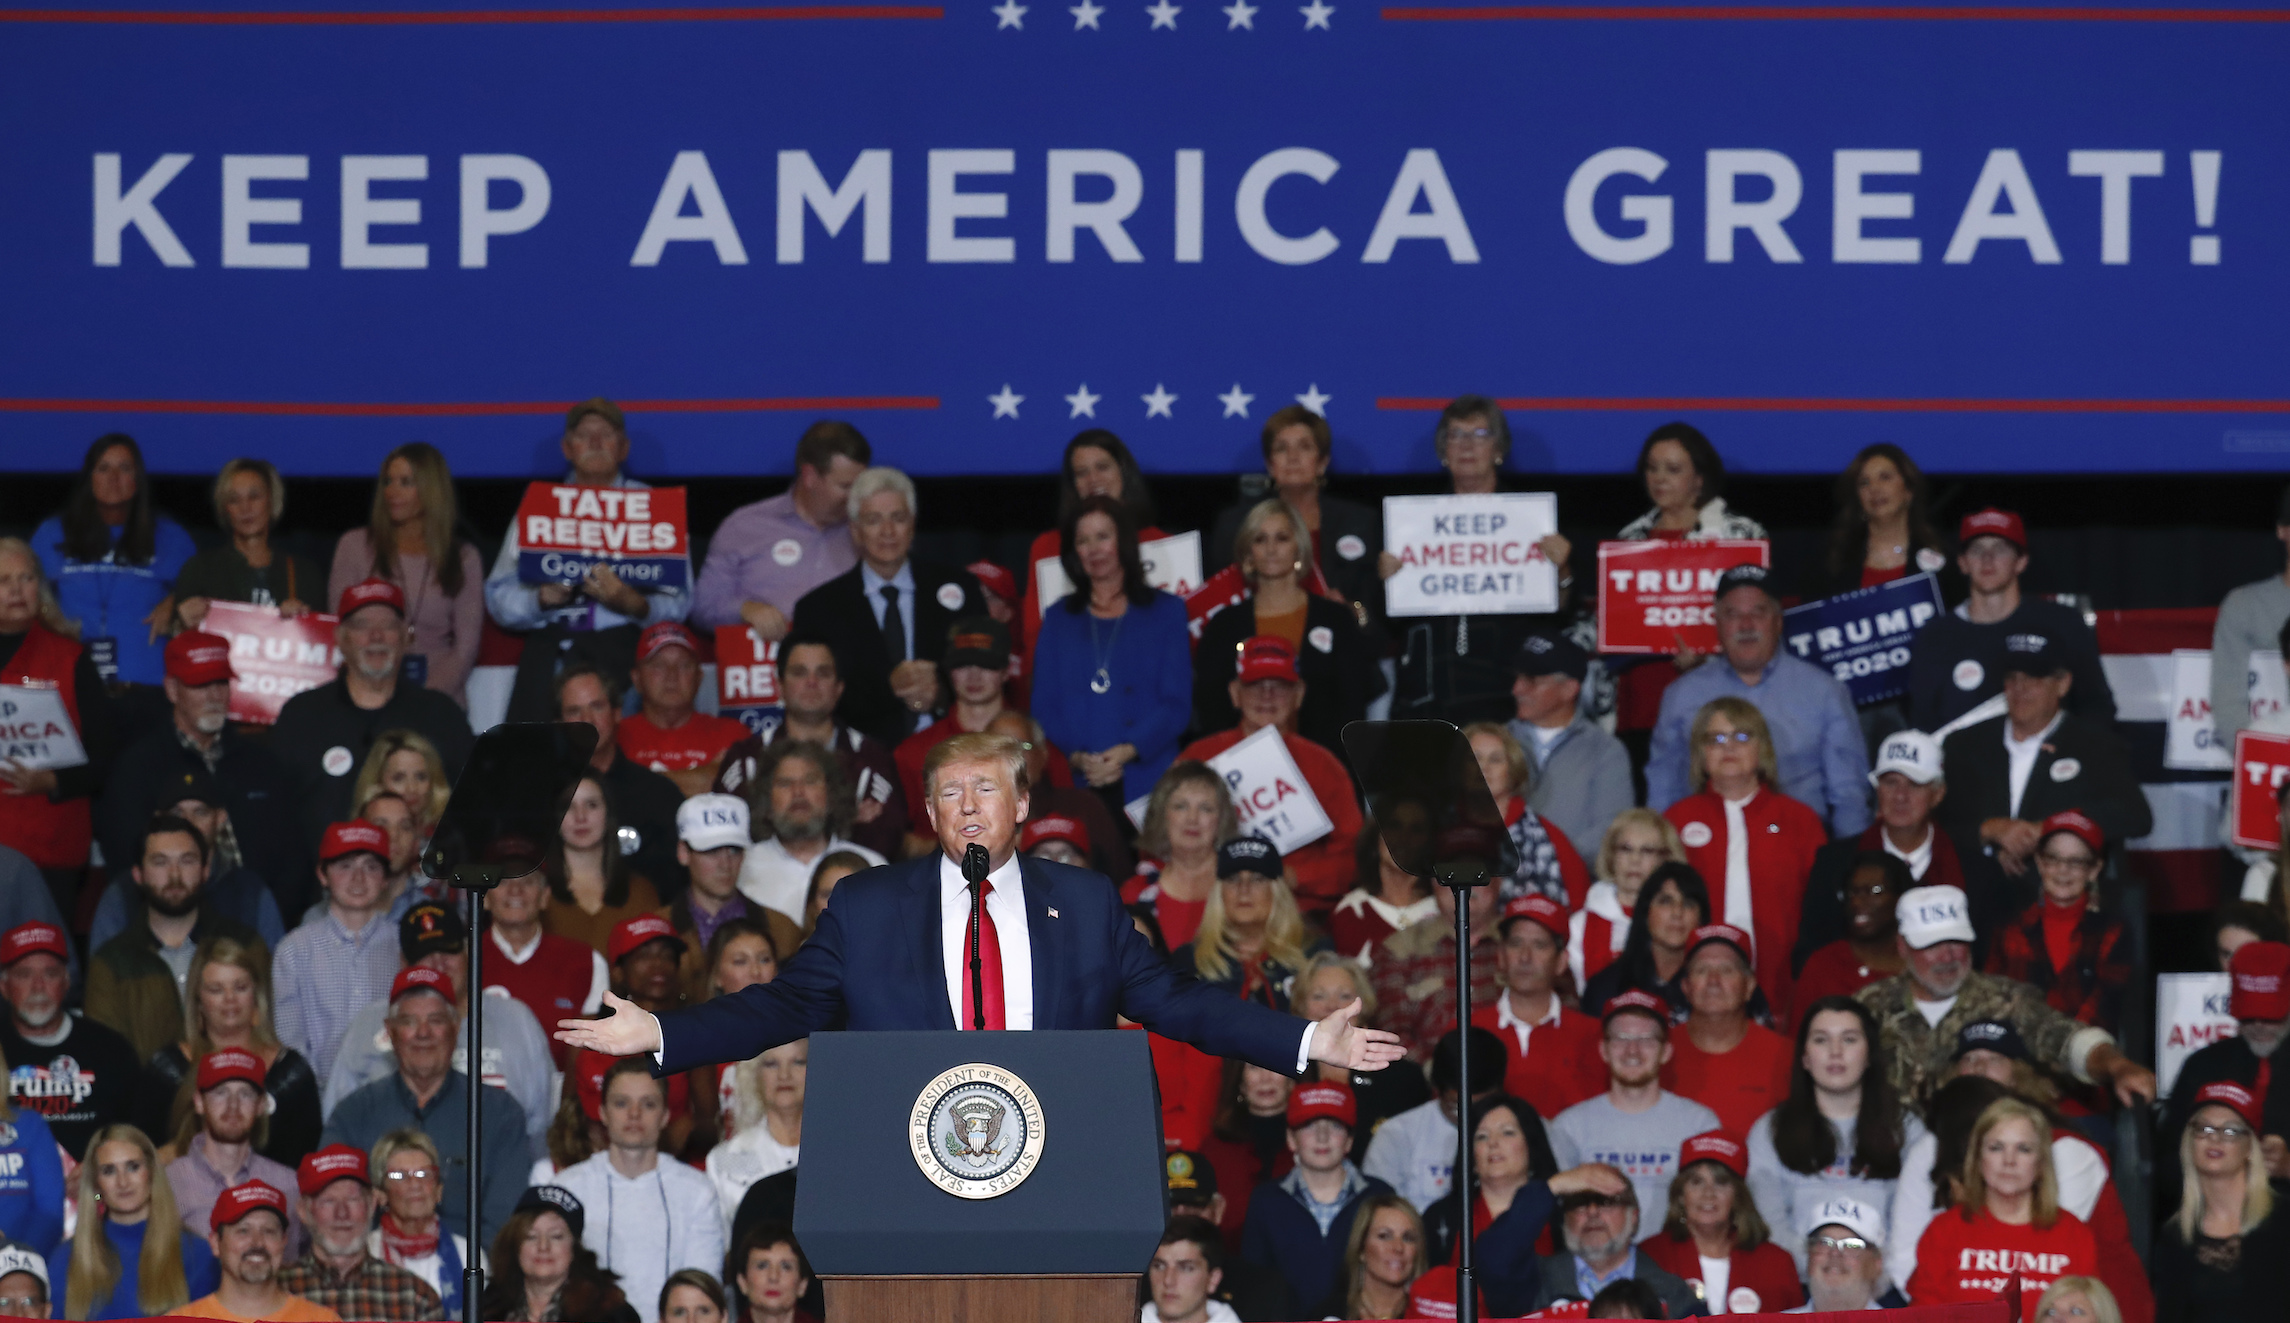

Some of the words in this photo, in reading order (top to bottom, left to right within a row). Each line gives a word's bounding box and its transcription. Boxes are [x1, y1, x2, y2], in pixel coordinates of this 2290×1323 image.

[94, 154, 551, 269] KEEP
[631, 149, 1479, 266] AMERICA
[1564, 147, 2221, 264] GREAT!
[552, 486, 650, 521] TATE
[526, 515, 677, 551] REEVES
[1434, 514, 1507, 536] KEEP
[541, 553, 664, 581] Govrnor
[1401, 542, 1546, 567] AMERICA
[1420, 572, 1525, 596] GREAT!
[1609, 568, 1724, 593] TRUM
[1788, 601, 1936, 657] TRUMP
[1832, 646, 1912, 682] 2020
[1887, 742, 1920, 764] USA
[702, 809, 741, 827] USA
[1919, 903, 1959, 925] USA
[978, 1070, 992, 1079] OF
[993, 1073, 1011, 1087] THE
[913, 1068, 975, 1128] PRESIDENT
[1012, 1085, 1041, 1140] UNITED
[915, 1131, 927, 1151] THE
[920, 1152, 932, 1165] OF
[1594, 1152, 1672, 1165] TRUMP
[931, 1163, 965, 1192] SEAL
[988, 1151, 1035, 1192] STATES
[1823, 1202, 1861, 1220] USA
[1957, 1247, 2071, 1275] TRUMP
